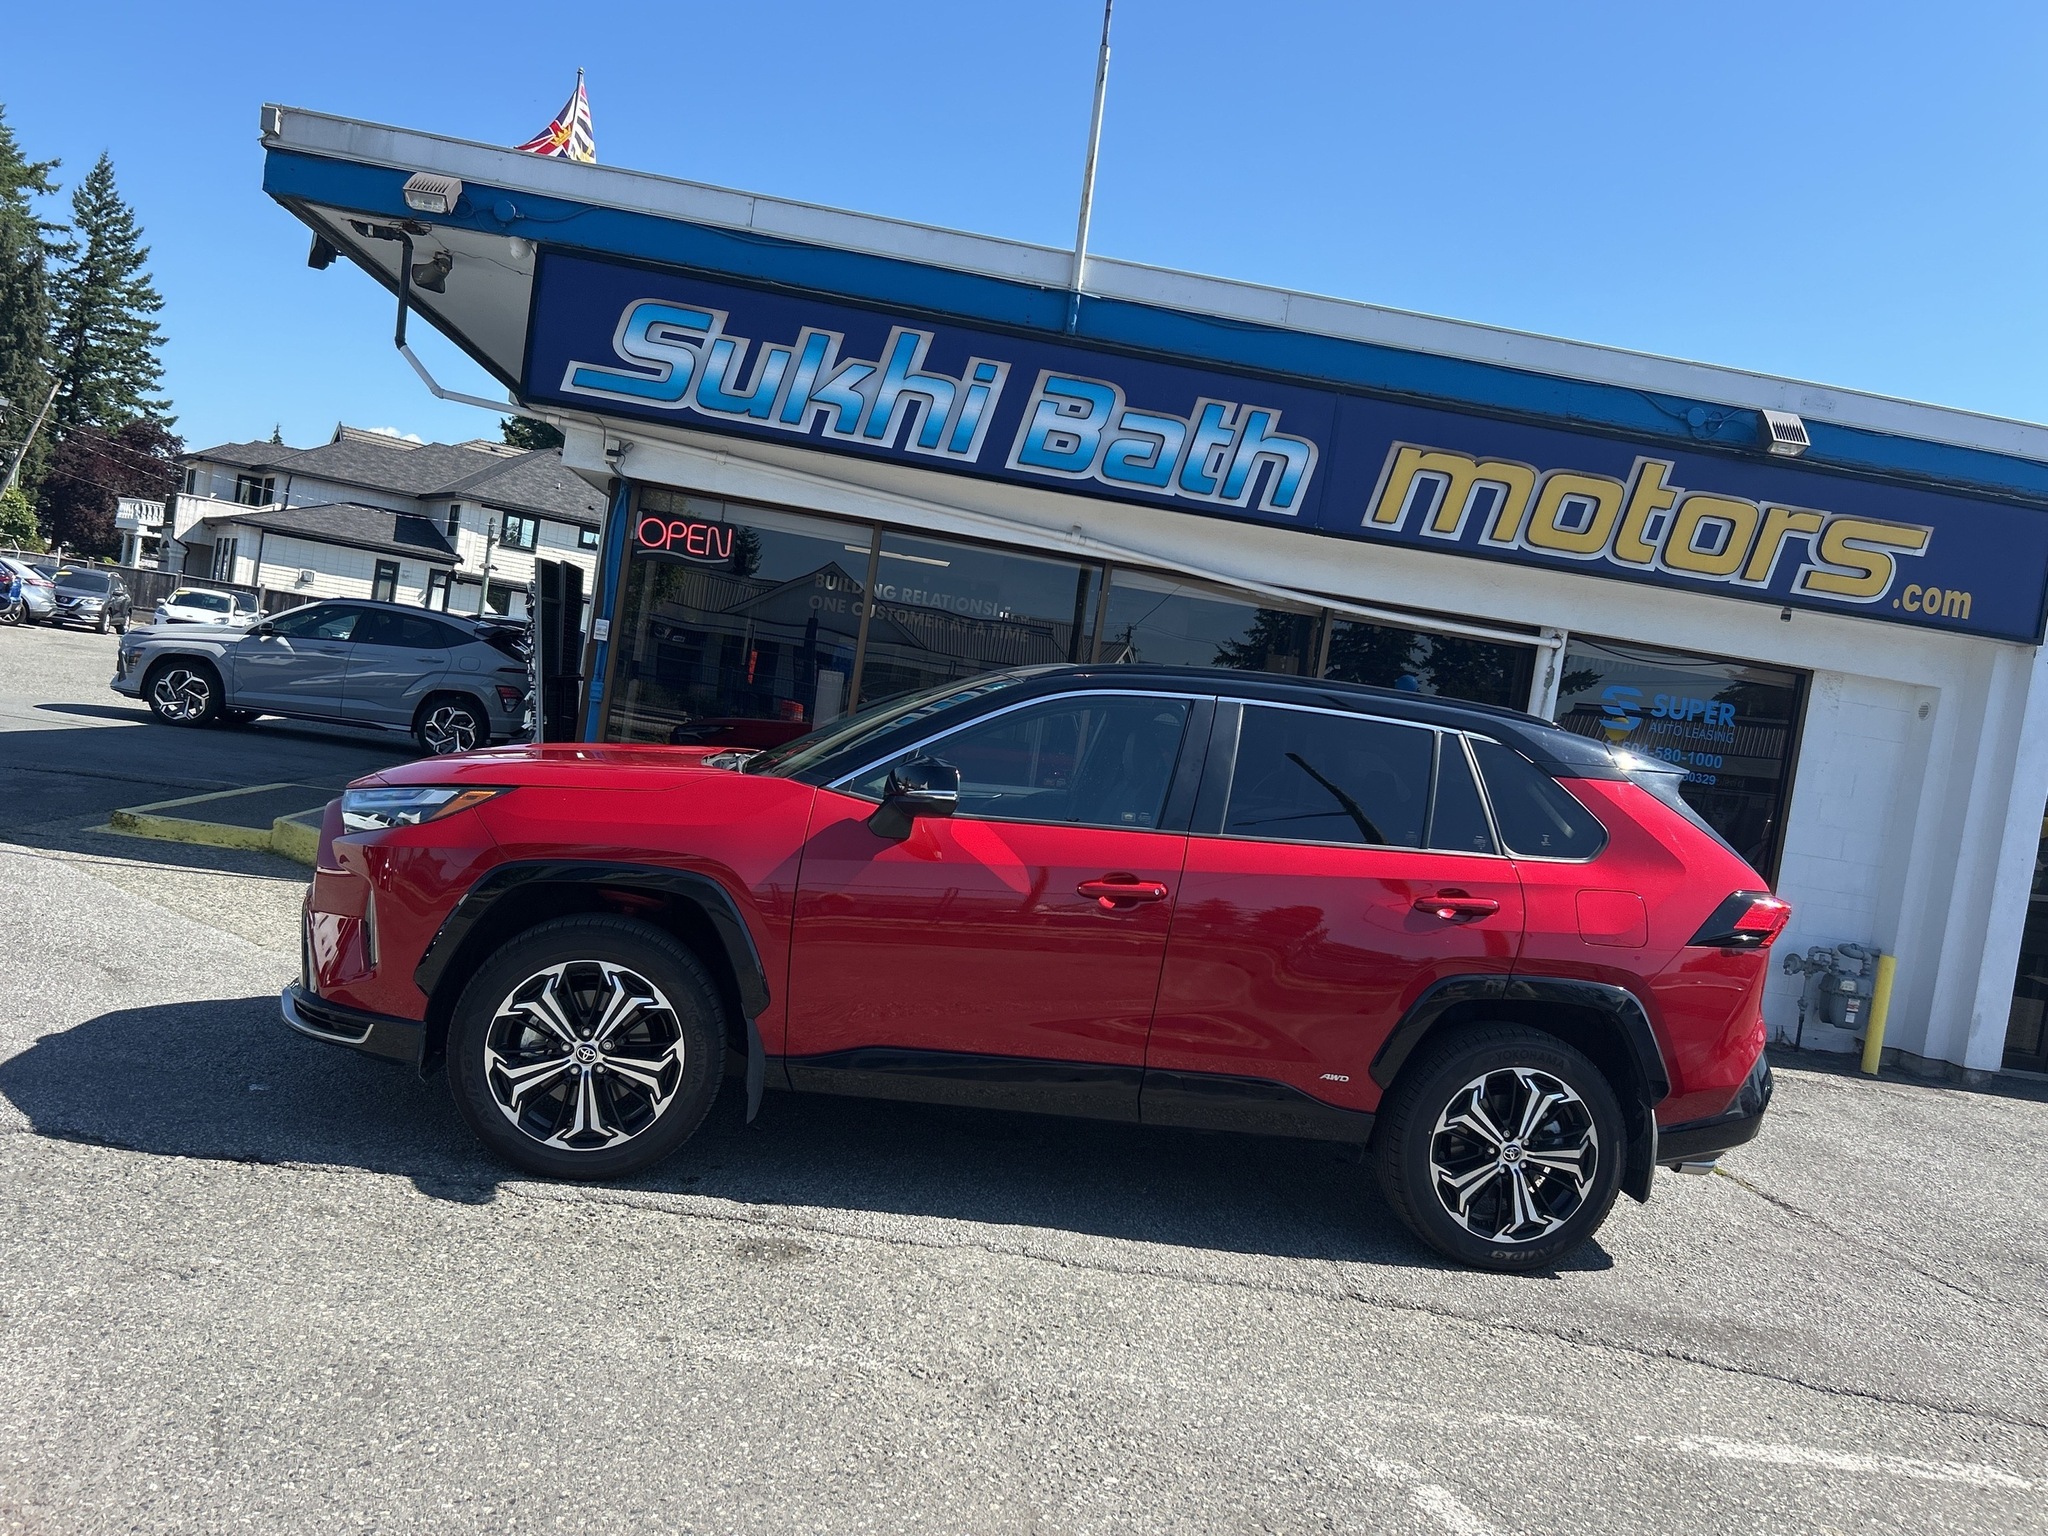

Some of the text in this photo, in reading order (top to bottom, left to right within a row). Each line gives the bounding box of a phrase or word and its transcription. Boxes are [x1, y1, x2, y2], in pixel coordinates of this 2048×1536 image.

[560, 297, 1972, 620] Sukhi Bath motors .com
[638, 517, 732, 557] OPEN
[814, 573, 896, 600] BUILDNG
[808, 595, 846, 614] ONE
[1650, 693, 1736, 727] SUPER
[1648, 722, 1734, 743] AUTO LEASING
[1495, 1048, 1565, 1070] YOKOHAMA
[1319, 1073, 1350, 1082] AWD
